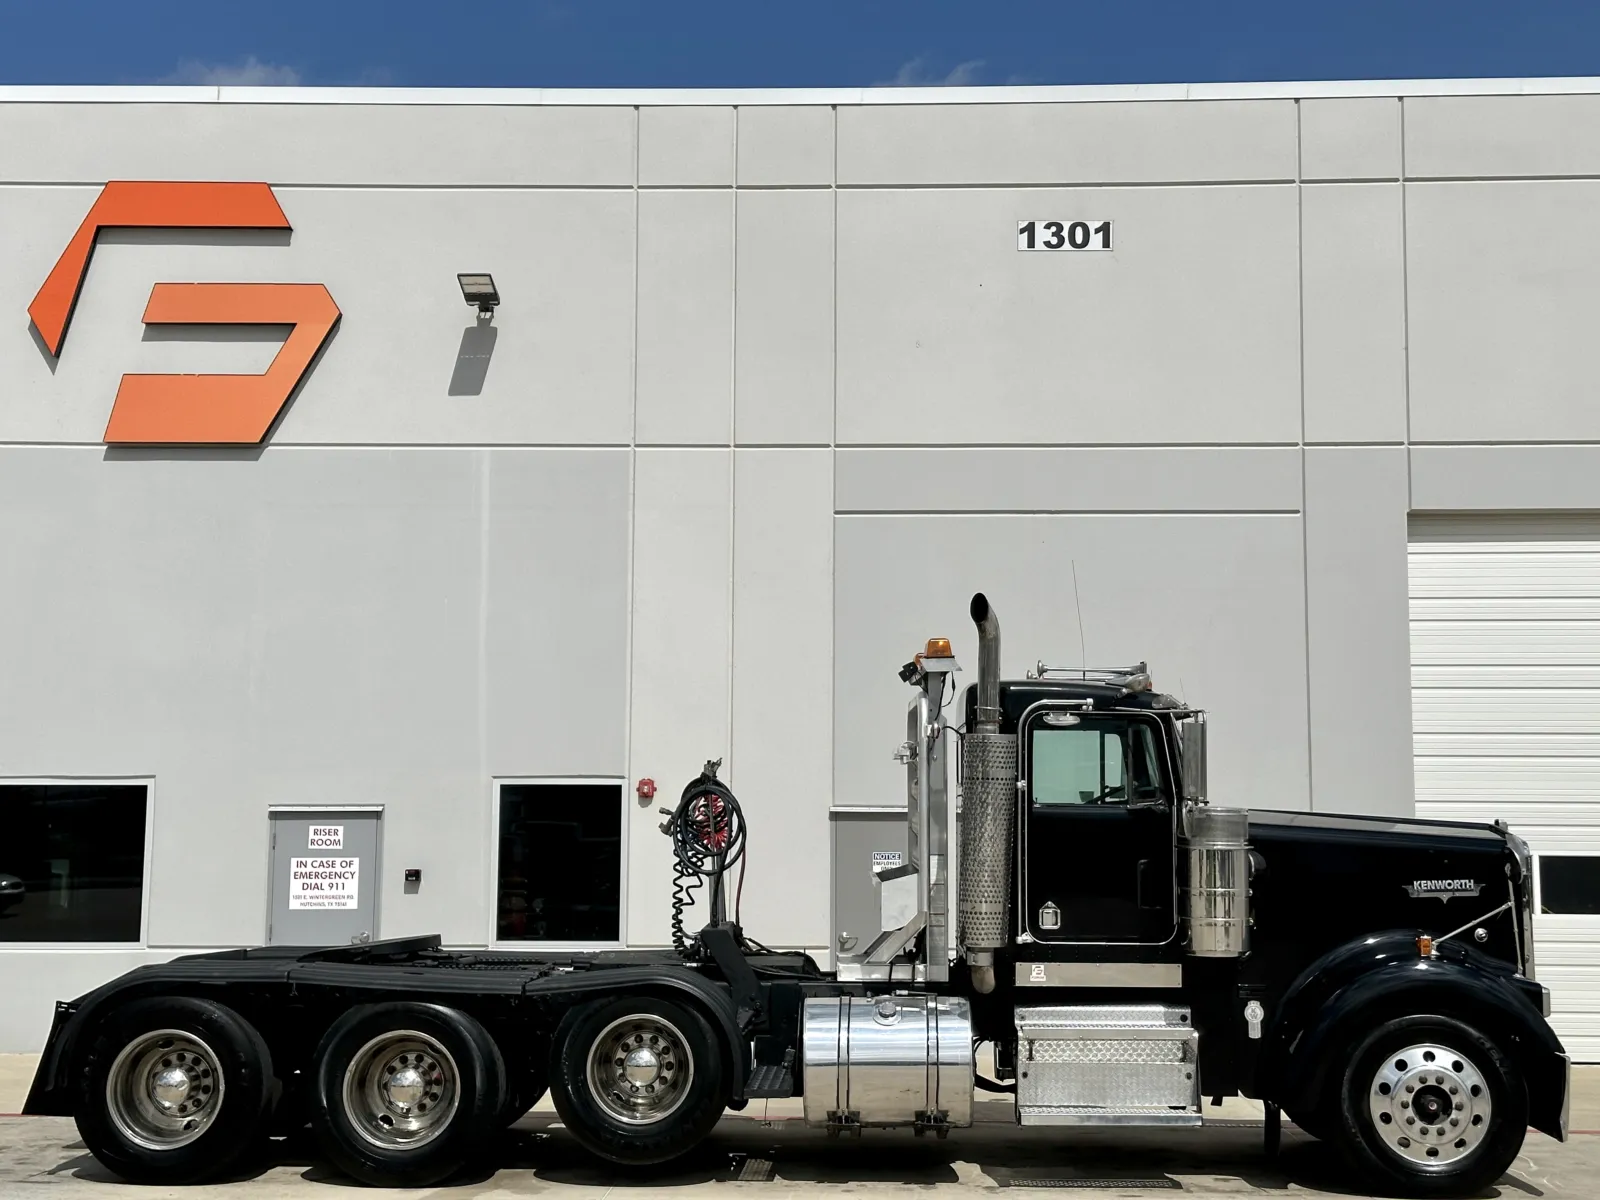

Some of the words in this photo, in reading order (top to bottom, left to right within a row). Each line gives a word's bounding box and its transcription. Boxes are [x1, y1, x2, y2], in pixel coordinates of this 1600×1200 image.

[1019, 221, 1110, 249] 1301
[313, 828, 339, 836] RISER
[310, 838, 341, 846] ROOM
[296, 860, 308, 868] IN
[311, 860, 337, 868] CASE
[340, 860, 354, 868] OF
[293, 871, 356, 880] EMERGENCY
[302, 882, 325, 891] DIAL
[328, 882, 345, 891] 911
[1413, 879, 1474, 890] KENWORTH
